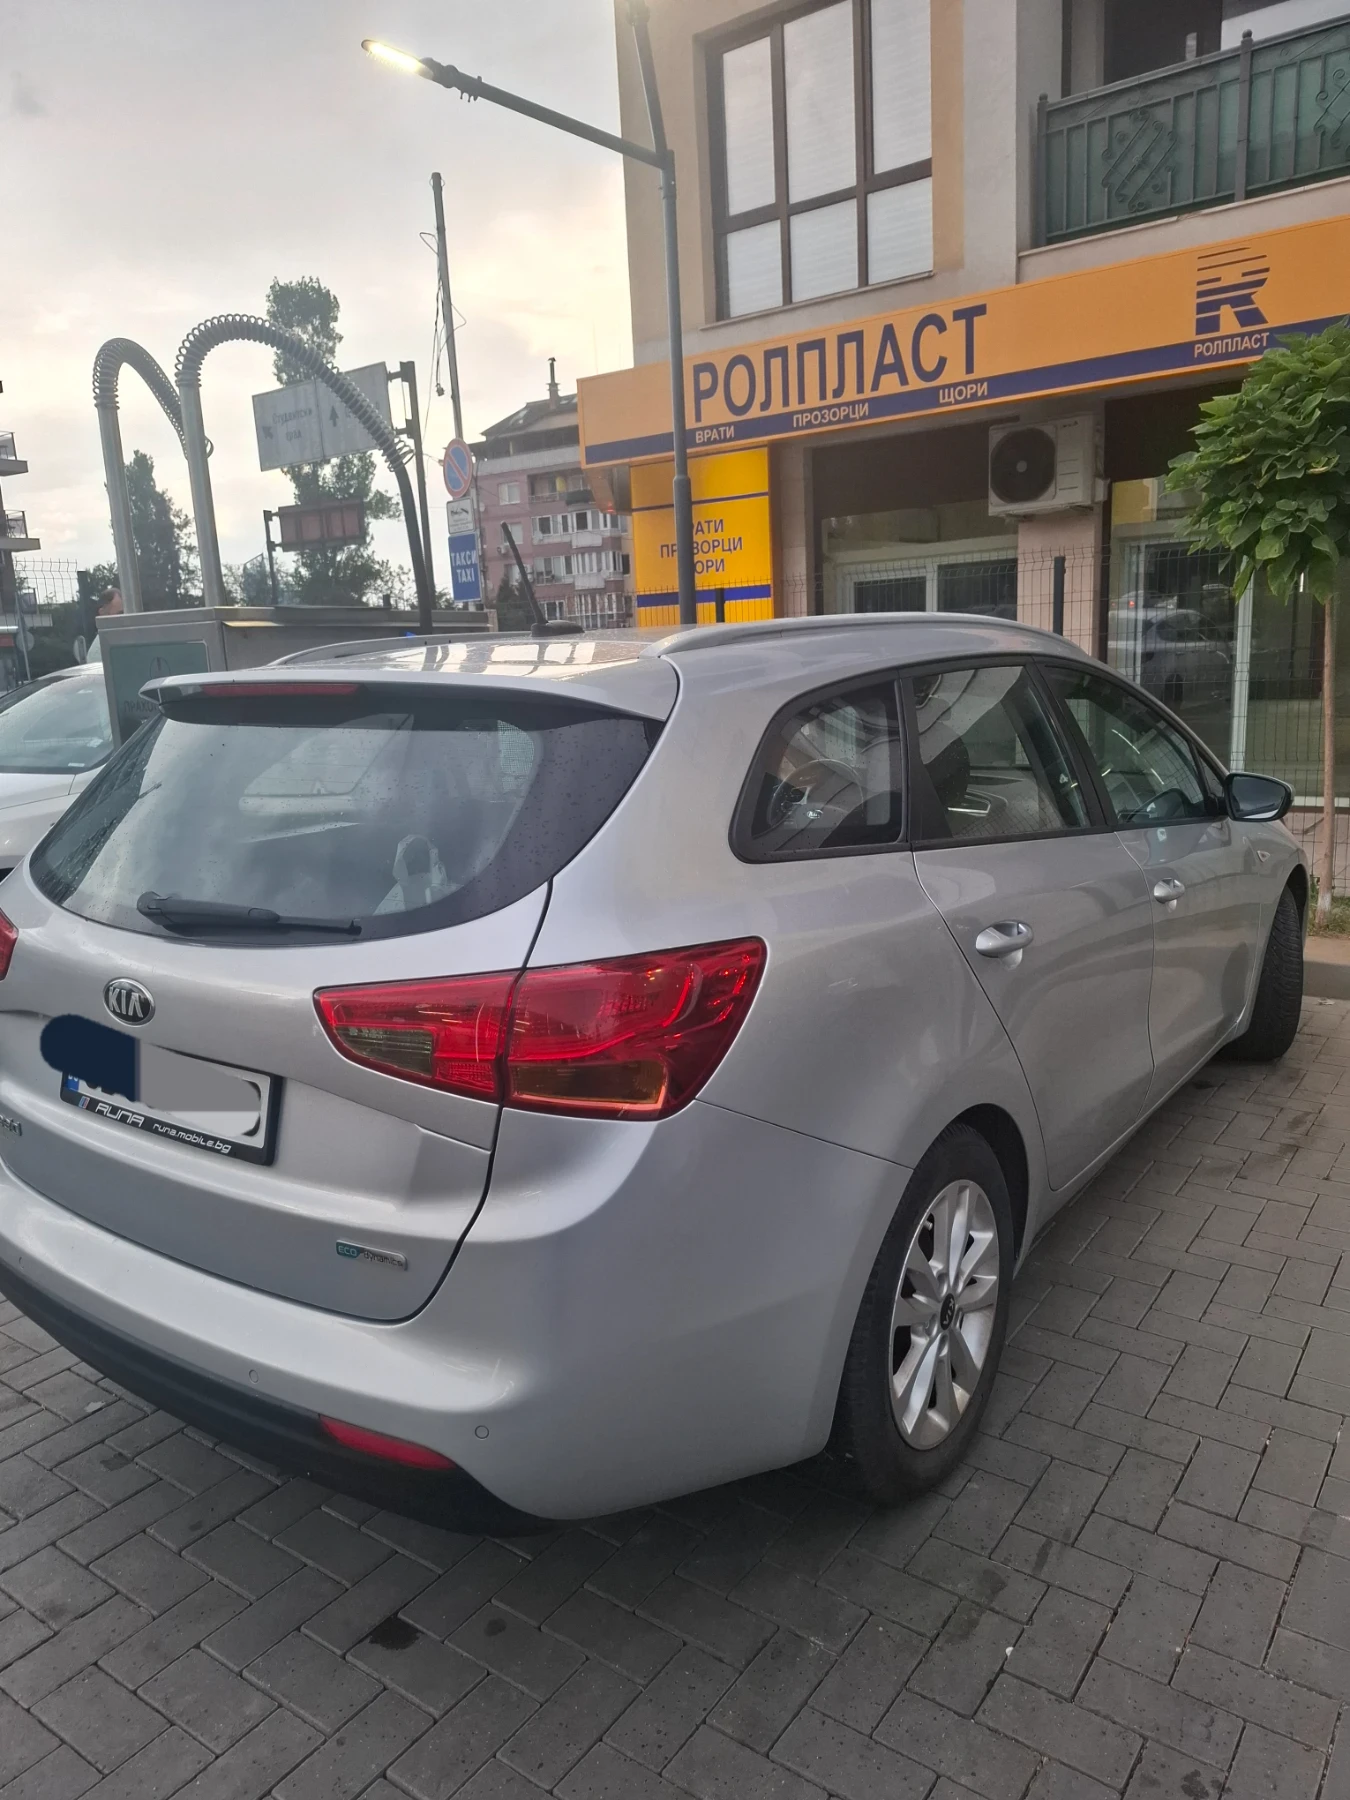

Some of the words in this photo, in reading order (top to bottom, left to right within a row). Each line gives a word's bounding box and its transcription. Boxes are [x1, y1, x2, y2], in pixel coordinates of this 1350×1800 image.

[1194, 332, 1269, 358] РОЛПЛАСТ
[692, 303, 987, 423] РОЛПЛАСТ
[695, 425, 734, 444] ВРАТИ
[792, 402, 869, 428] ПРОЗОРЦИ
[939, 381, 988, 404] ЩОРИ
[693, 519, 724, 535] АТИ
[450, 550, 478, 567] ТАКСИ
[660, 537, 742, 558] ПРЗОРЦИ
[456, 567, 475, 584] TAXI
[694, 558, 725, 574] ОРИ
[108, 986, 144, 1018] KIA
[95, 1102, 145, 1128] RUNA
[152, 1122, 232, 1154] runa.mobile.bg
[338, 1245, 357, 1257] ECO
[363, 1251, 404, 1267] dynamics
